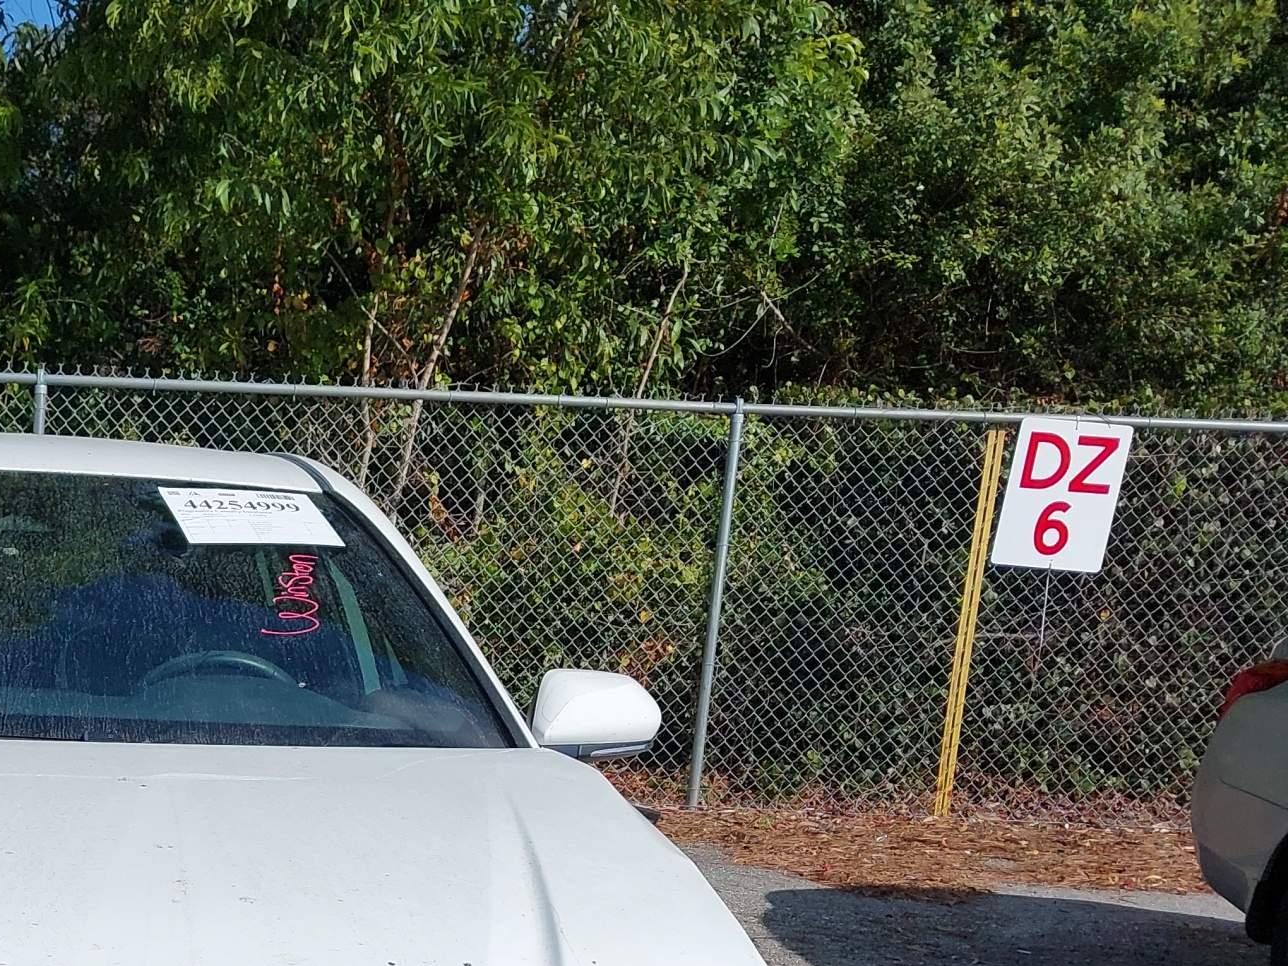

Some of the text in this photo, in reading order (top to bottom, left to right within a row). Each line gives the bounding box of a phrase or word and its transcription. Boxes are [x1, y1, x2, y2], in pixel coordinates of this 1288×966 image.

[1019, 431, 1120, 494] DZ
[183, 499, 300, 512] 44254999
[1033, 501, 1072, 556] 6
